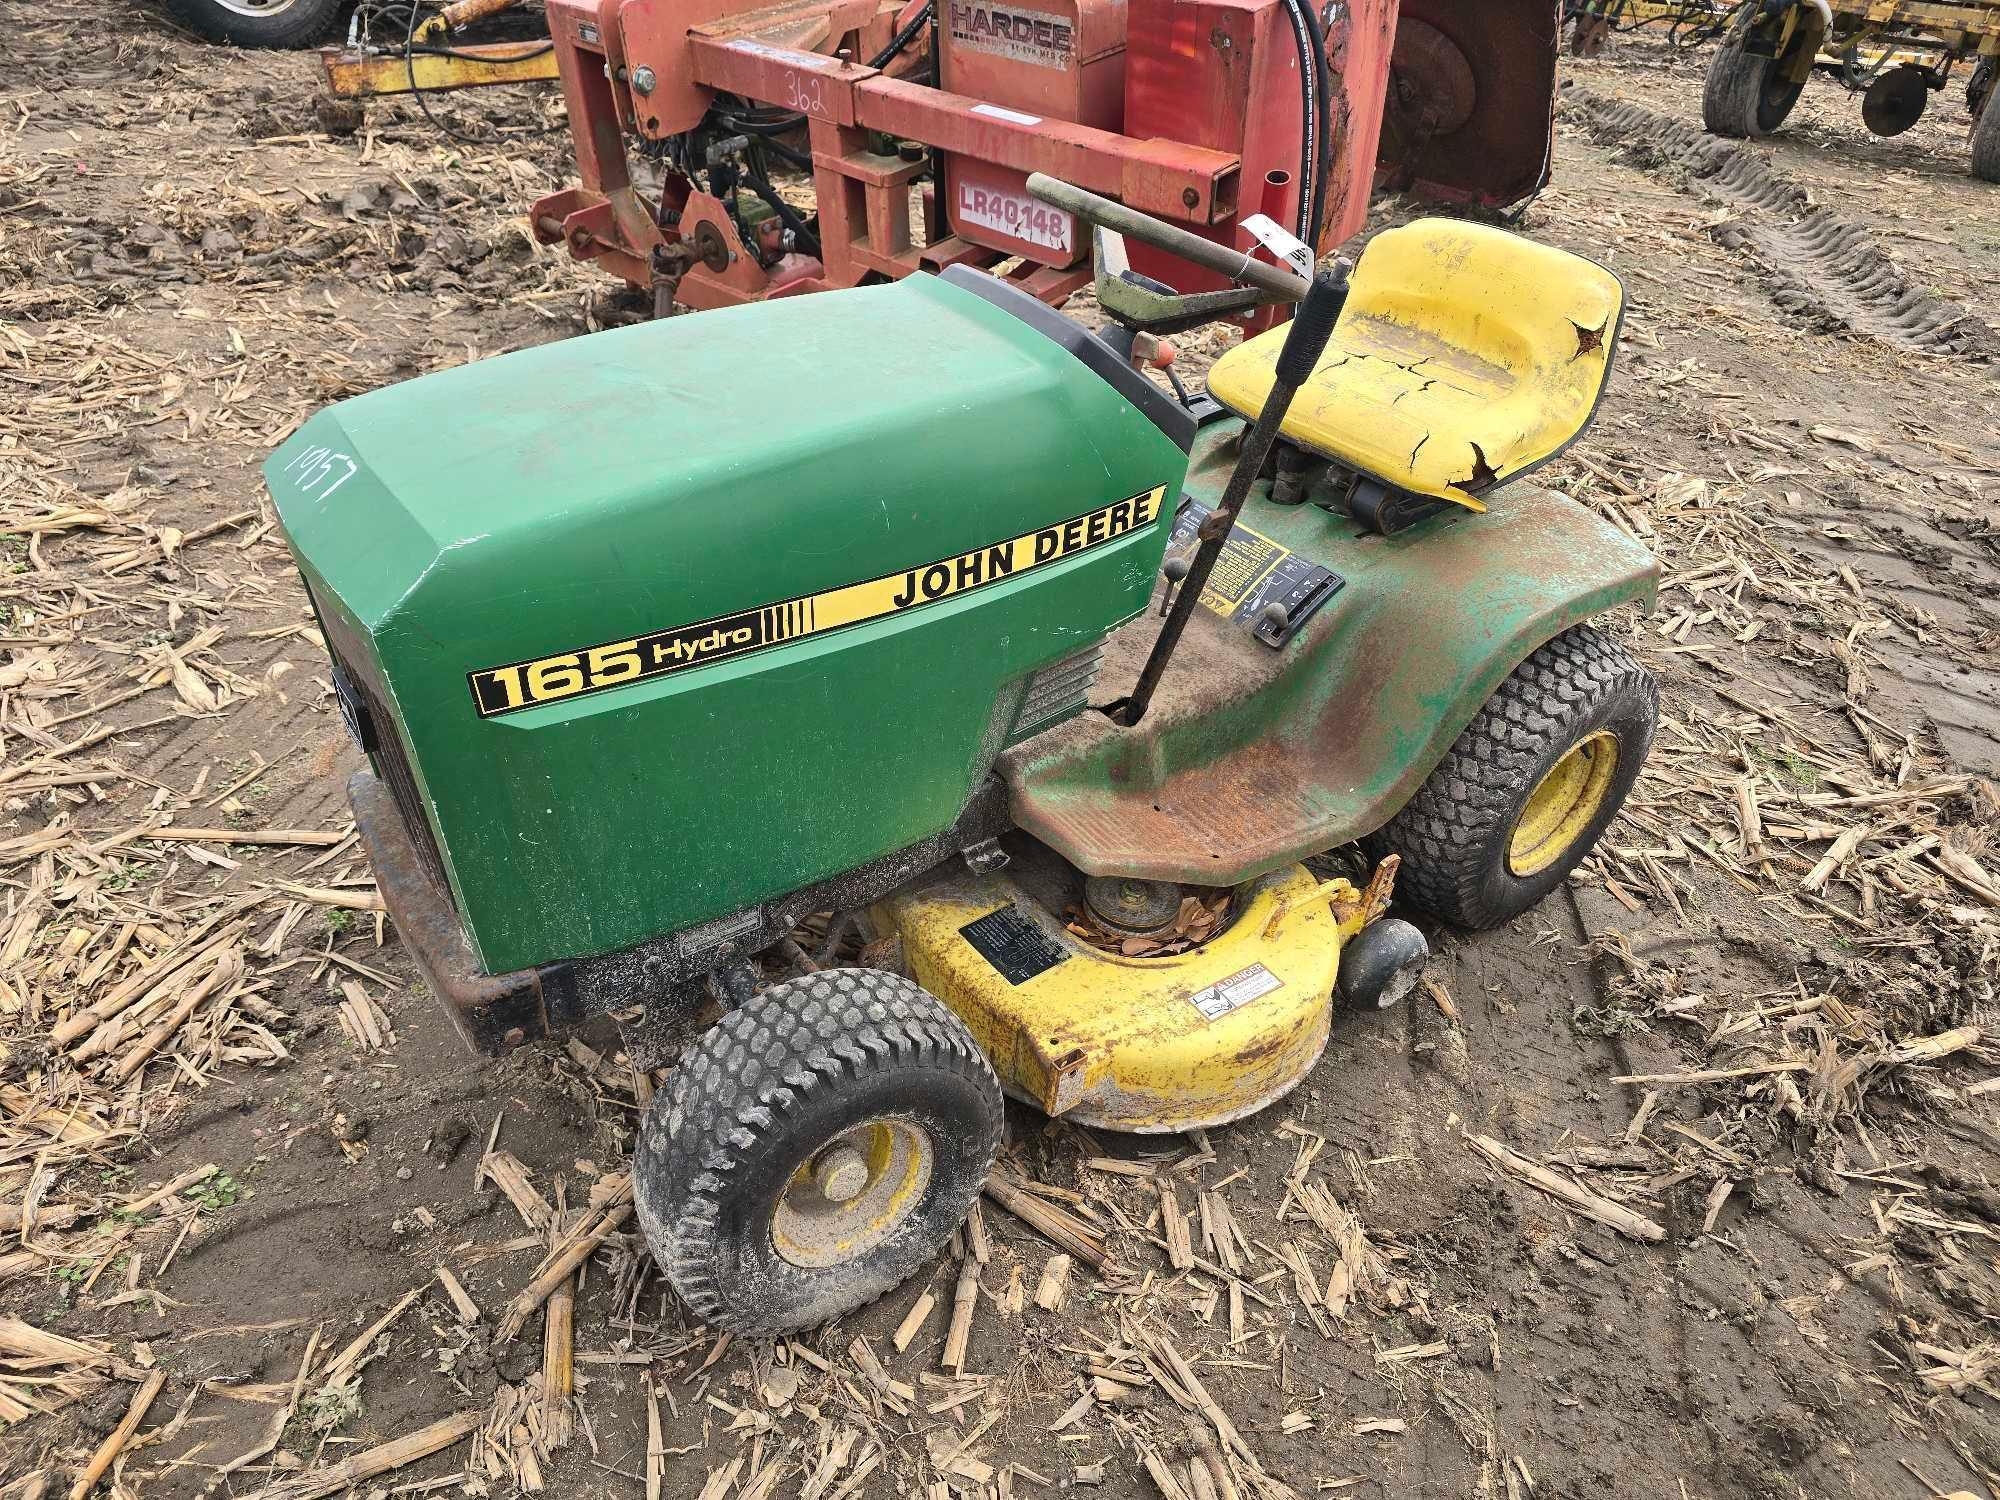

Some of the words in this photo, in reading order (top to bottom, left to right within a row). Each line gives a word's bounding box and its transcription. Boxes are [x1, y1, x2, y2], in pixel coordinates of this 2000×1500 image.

[951, 3, 1072, 52] HARDEE
[784, 70, 828, 115] 362
[960, 186, 1063, 238] LR40148
[284, 445, 358, 503] 1957
[493, 640, 642, 707] 165
[652, 627, 752, 664] Hydro
[893, 542, 1014, 608] JOHN
[1034, 493, 1152, 563] DEERE
[1224, 964, 1265, 987] DANGER
